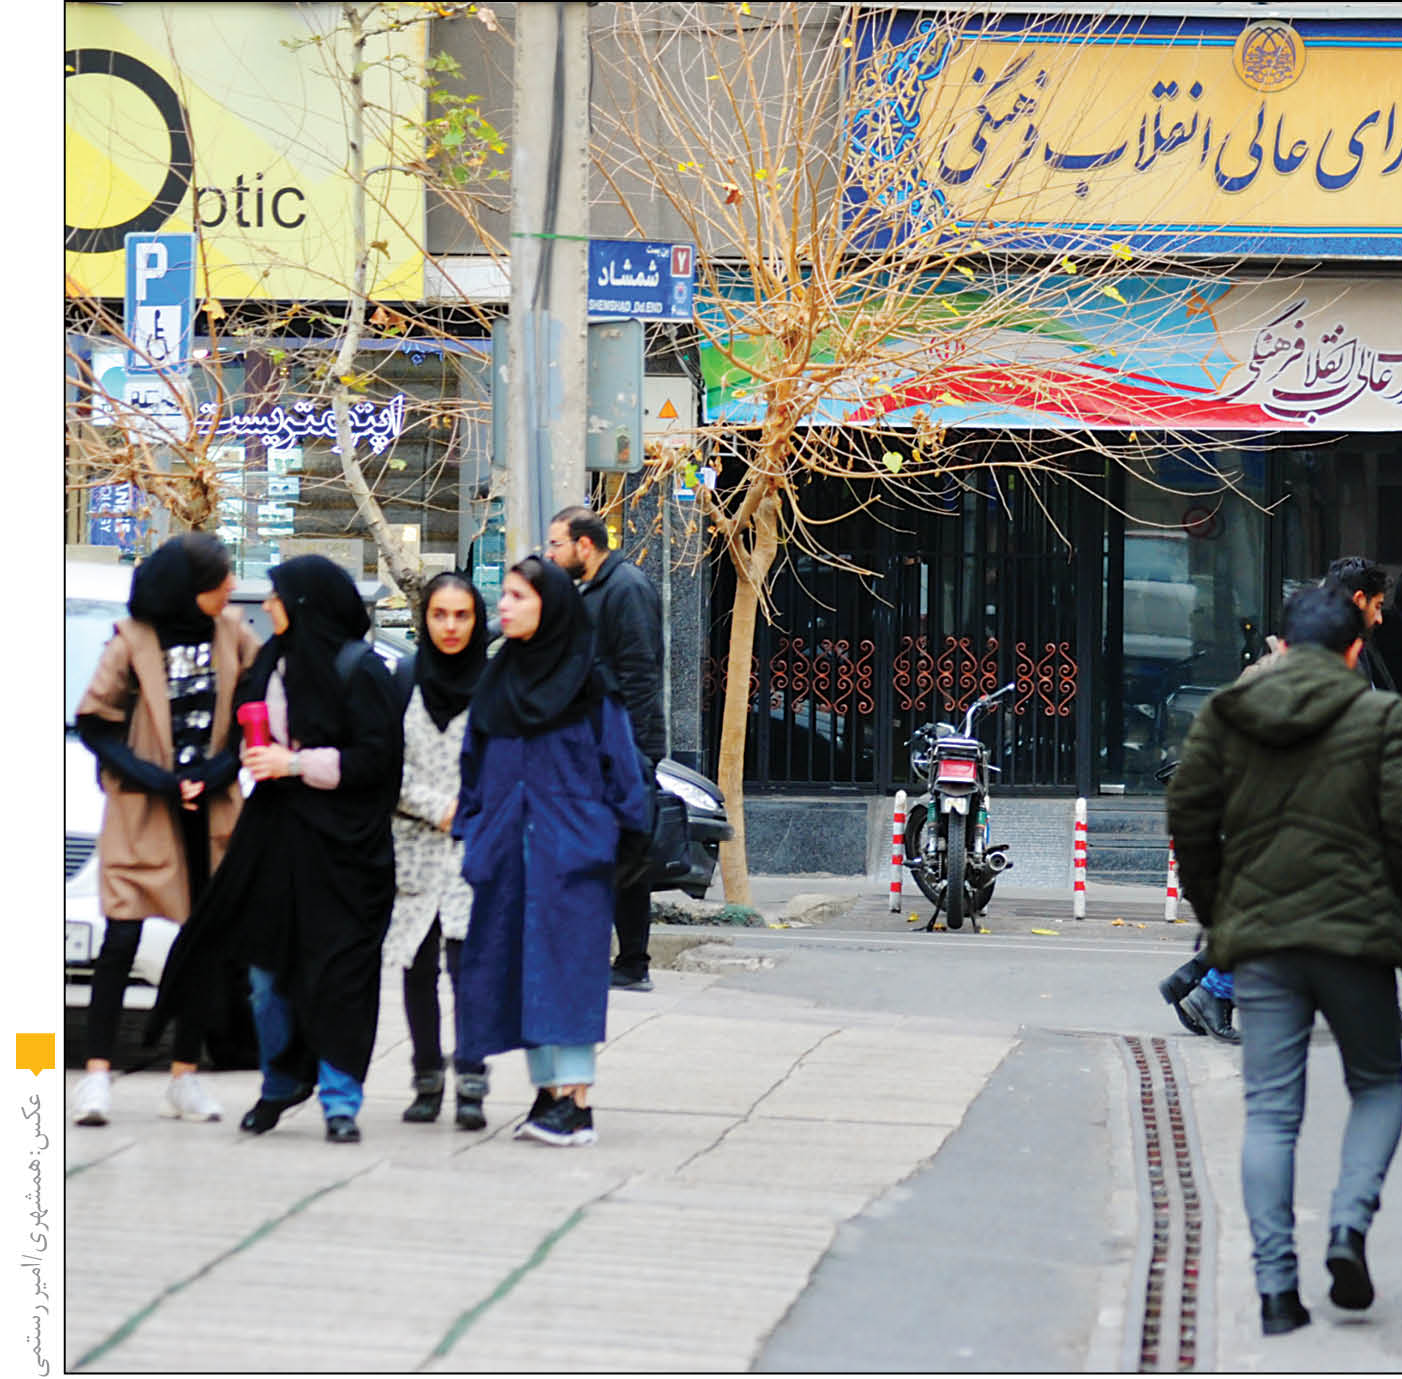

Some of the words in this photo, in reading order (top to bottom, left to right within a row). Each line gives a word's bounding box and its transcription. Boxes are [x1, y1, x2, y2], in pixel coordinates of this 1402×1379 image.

[938, 51, 1047, 190] فرهنگی
[1043, 80, 1213, 197] انقلاب
[1214, 100, 1309, 194] عالی
[136, 243, 168, 300] P
[597, 257, 660, 287] شمشاد
[1212, 300, 1308, 402] فرهنگی
